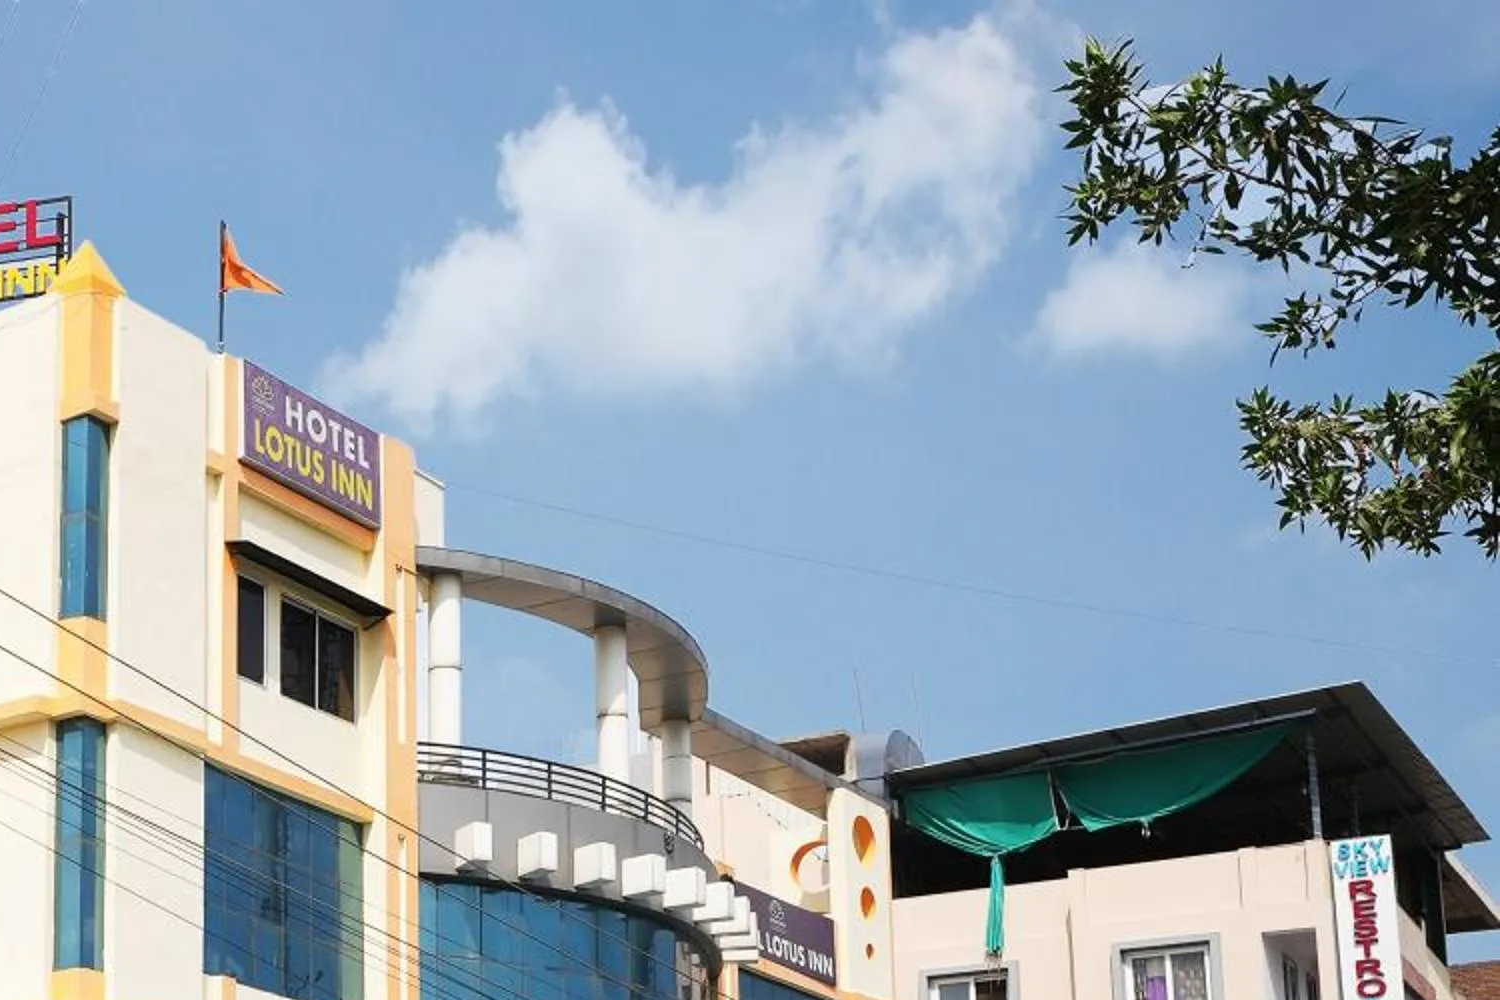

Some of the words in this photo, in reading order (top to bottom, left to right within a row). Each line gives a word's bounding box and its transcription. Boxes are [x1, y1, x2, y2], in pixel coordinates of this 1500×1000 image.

[285, 396, 370, 469] HOTEL
[254, 418, 325, 485] LOTUS
[331, 459, 373, 511] INN
[1334, 855, 1391, 880] VIEW
[1337, 838, 1384, 861] SKY
[764, 931, 805, 967] LOTUS
[807, 949, 834, 978] INN
[1348, 879, 1388, 999] RESTRO
